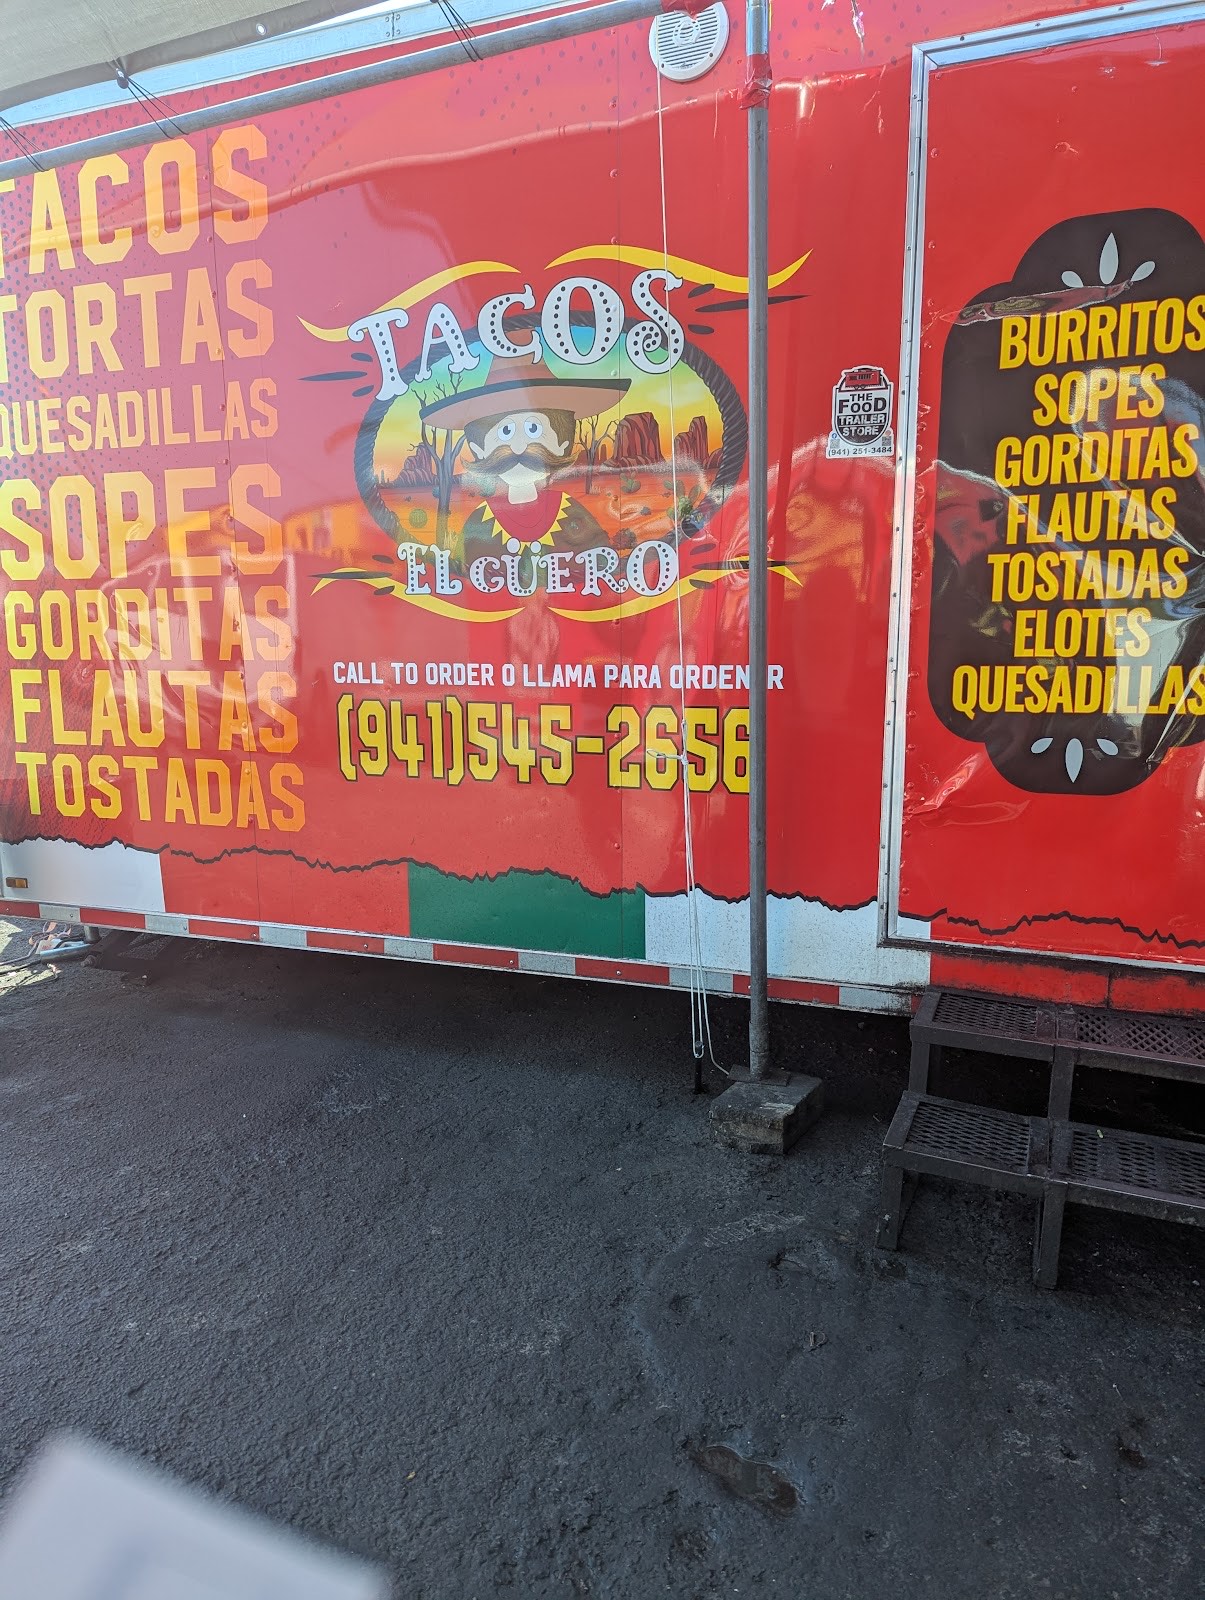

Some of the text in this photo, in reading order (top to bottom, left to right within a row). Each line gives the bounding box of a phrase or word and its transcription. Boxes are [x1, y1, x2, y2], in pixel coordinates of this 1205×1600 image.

[0, 124, 269, 279] ACOS
[347, 268, 685, 401] TACOS
[998, 294, 1205, 370] BURRITOS
[838, 397, 887, 413] FOOD
[838, 415, 885, 425] TRAILER
[850, 392, 873, 402] THE
[1031, 363, 1167, 427] SOPES
[828, 446, 892, 457] (941) 251-3484
[842, 426, 879, 436] STORE
[994, 423, 1201, 489] GORDITAS
[0, 463, 284, 581] SOPES
[1005, 486, 1177, 546] FLAUTAS
[397, 538, 678, 597] EL GÜERO
[987, 547, 1190, 603] TOSTADAS
[5, 585, 293, 661] GORDITAS
[1012, 606, 1152, 659] ELOTES
[333, 662, 784, 690] CALL TO ORDER O LLAMA PARA ORDENR
[952, 664, 1205, 720] QUESADILLAS
[10, 669, 300, 754] FLAUTAS
[15, 751, 306, 832] TOSTADAS
